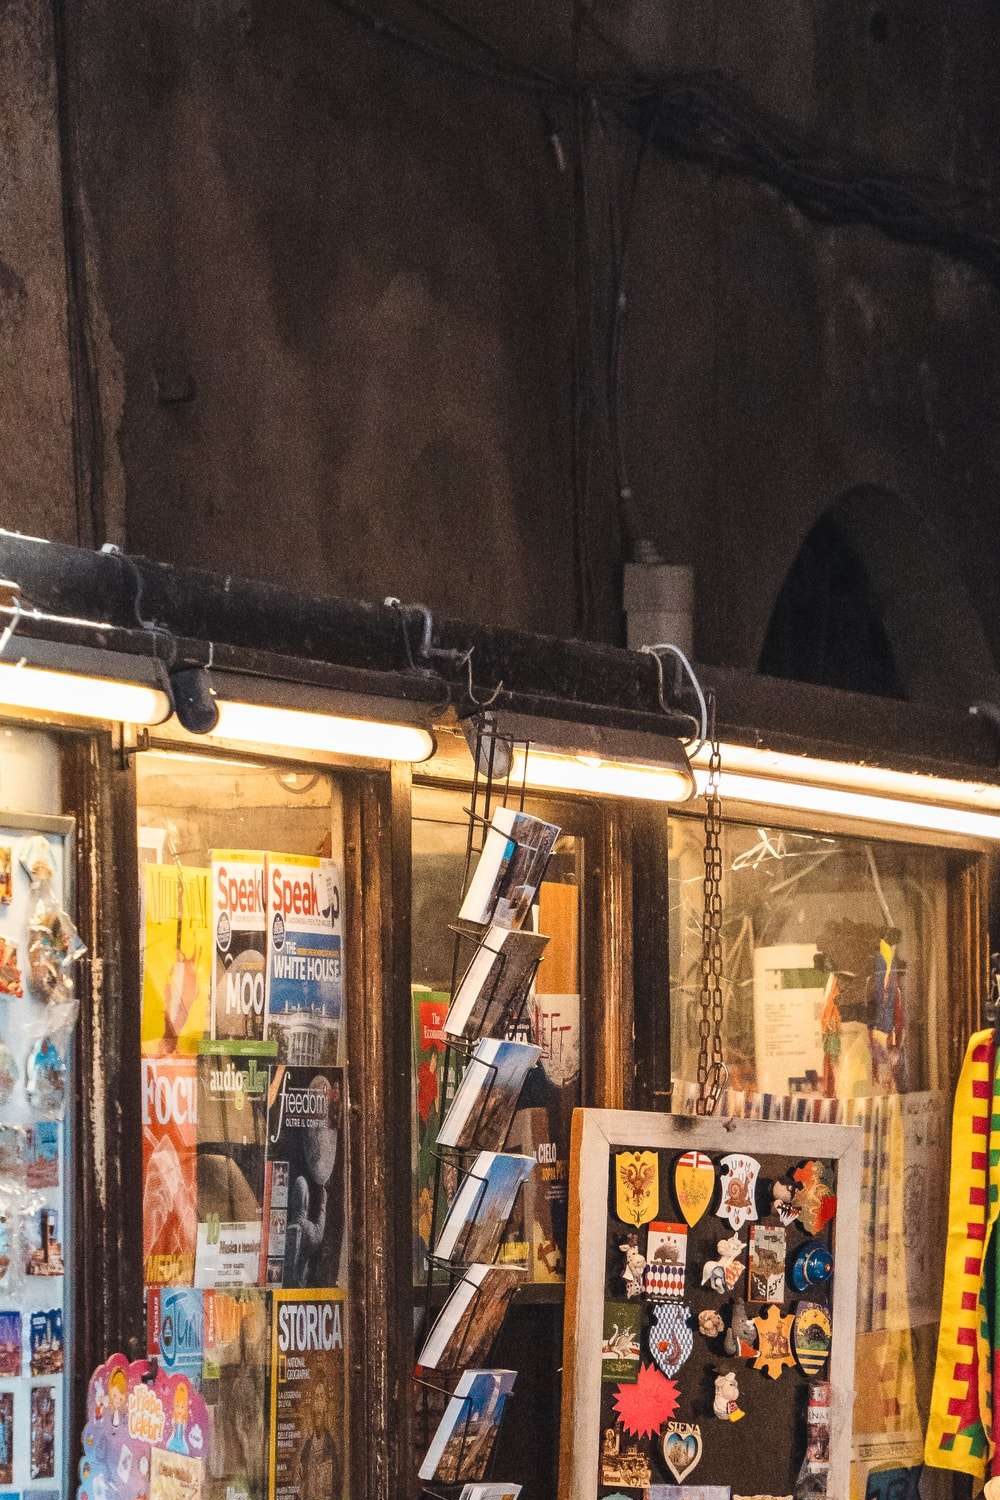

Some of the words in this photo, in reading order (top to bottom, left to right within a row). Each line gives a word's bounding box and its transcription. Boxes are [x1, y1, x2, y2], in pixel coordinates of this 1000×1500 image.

[286, 942, 296, 954] THE
[273, 956, 307, 980] WHITE
[308, 957, 340, 982] HOUSE
[432, 1013, 441, 1024] The
[538, 1143, 557, 1163] CIELO
[278, 1304, 342, 1351] STORICA
[667, 1421, 701, 1434] SIENA
